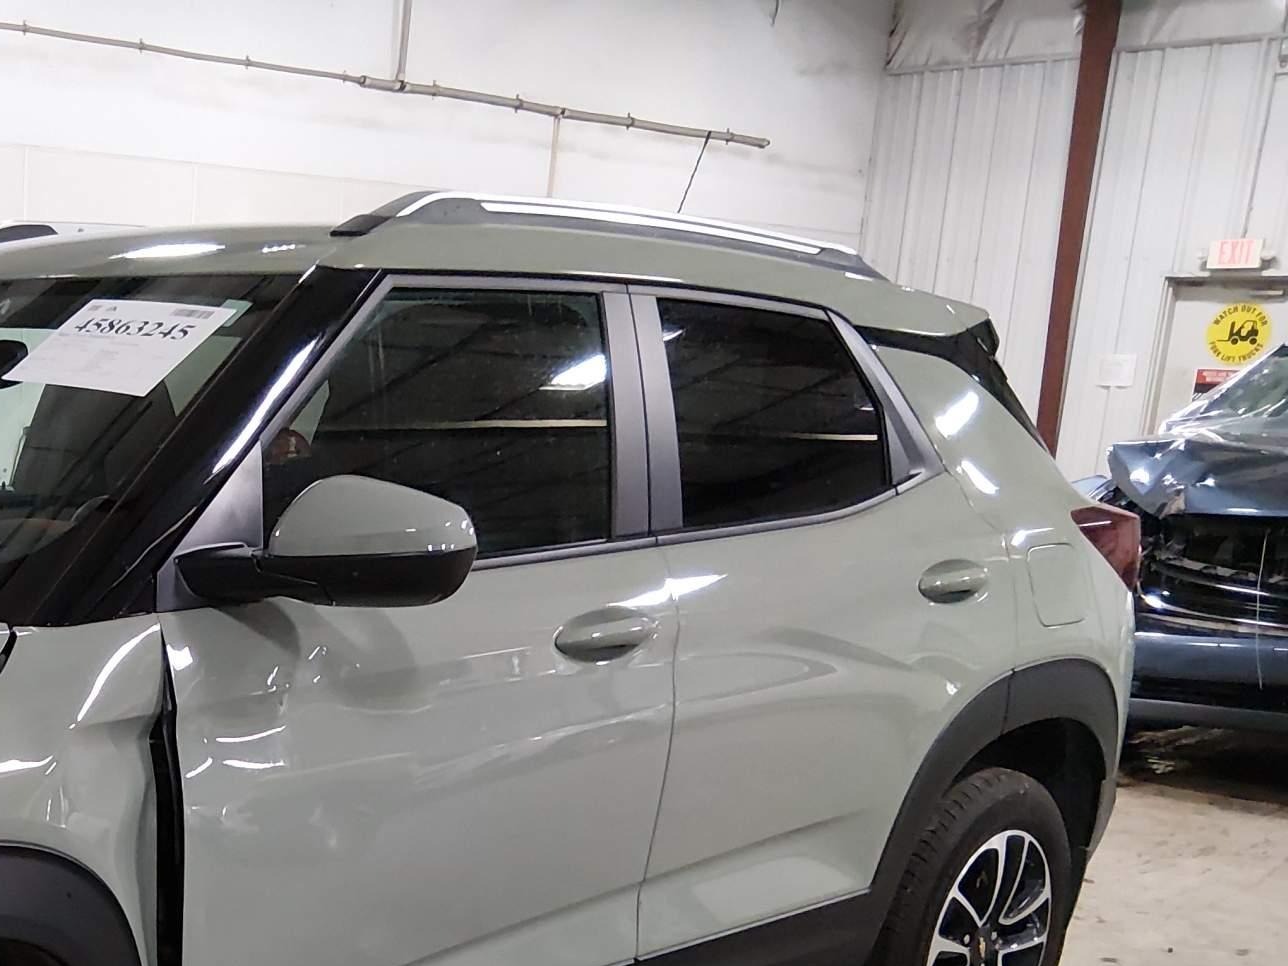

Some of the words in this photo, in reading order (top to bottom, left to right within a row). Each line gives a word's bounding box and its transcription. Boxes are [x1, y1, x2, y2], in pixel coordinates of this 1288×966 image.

[1218, 240, 1255, 265] EXIT
[1213, 304, 1238, 325] WATCH
[1240, 304, 1256, 314] OUT
[1255, 311, 1268, 326] FOR
[75, 318, 197, 340] 45863245
[1221, 353, 1235, 362] LIFT
[1238, 343, 1263, 361] TRUCKS
